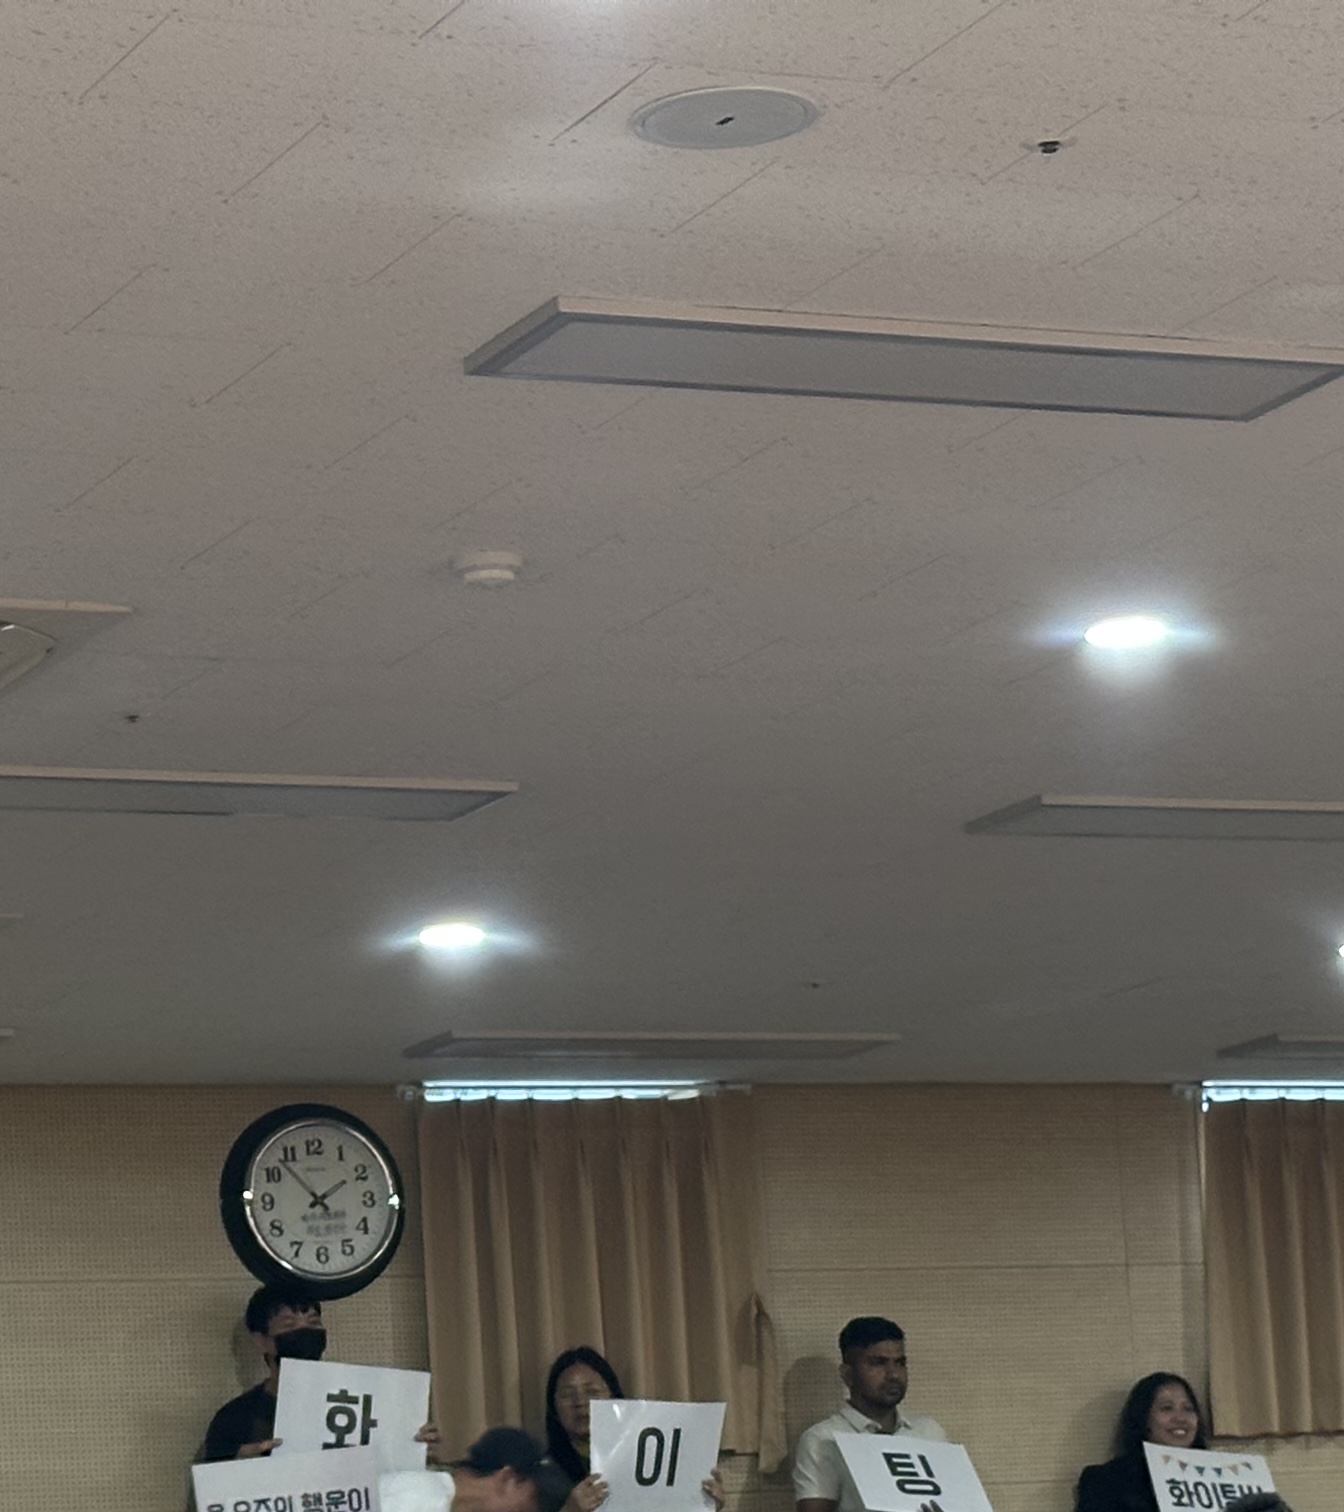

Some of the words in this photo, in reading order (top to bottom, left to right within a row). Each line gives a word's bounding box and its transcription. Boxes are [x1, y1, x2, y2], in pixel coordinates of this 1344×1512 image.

[282, 1146, 298, 1163] 11
[304, 1138, 324, 1157] 12
[336, 1145, 345, 1162] 1
[264, 1166, 282, 1184] 10
[354, 1163, 369, 1182] 2
[261, 1193, 275, 1212] 9
[362, 1190, 376, 1209] 3
[269, 1219, 284, 1237] 8
[355, 1216, 369, 1235] 4
[290, 1241, 304, 1258] 7
[316, 1246, 329, 1265] 6
[340, 1238, 355, 1256] 5
[321, 1388, 378, 1451] 화
[634, 1425, 682, 1488] 이
[881, 1451, 943, 1497] 팅
